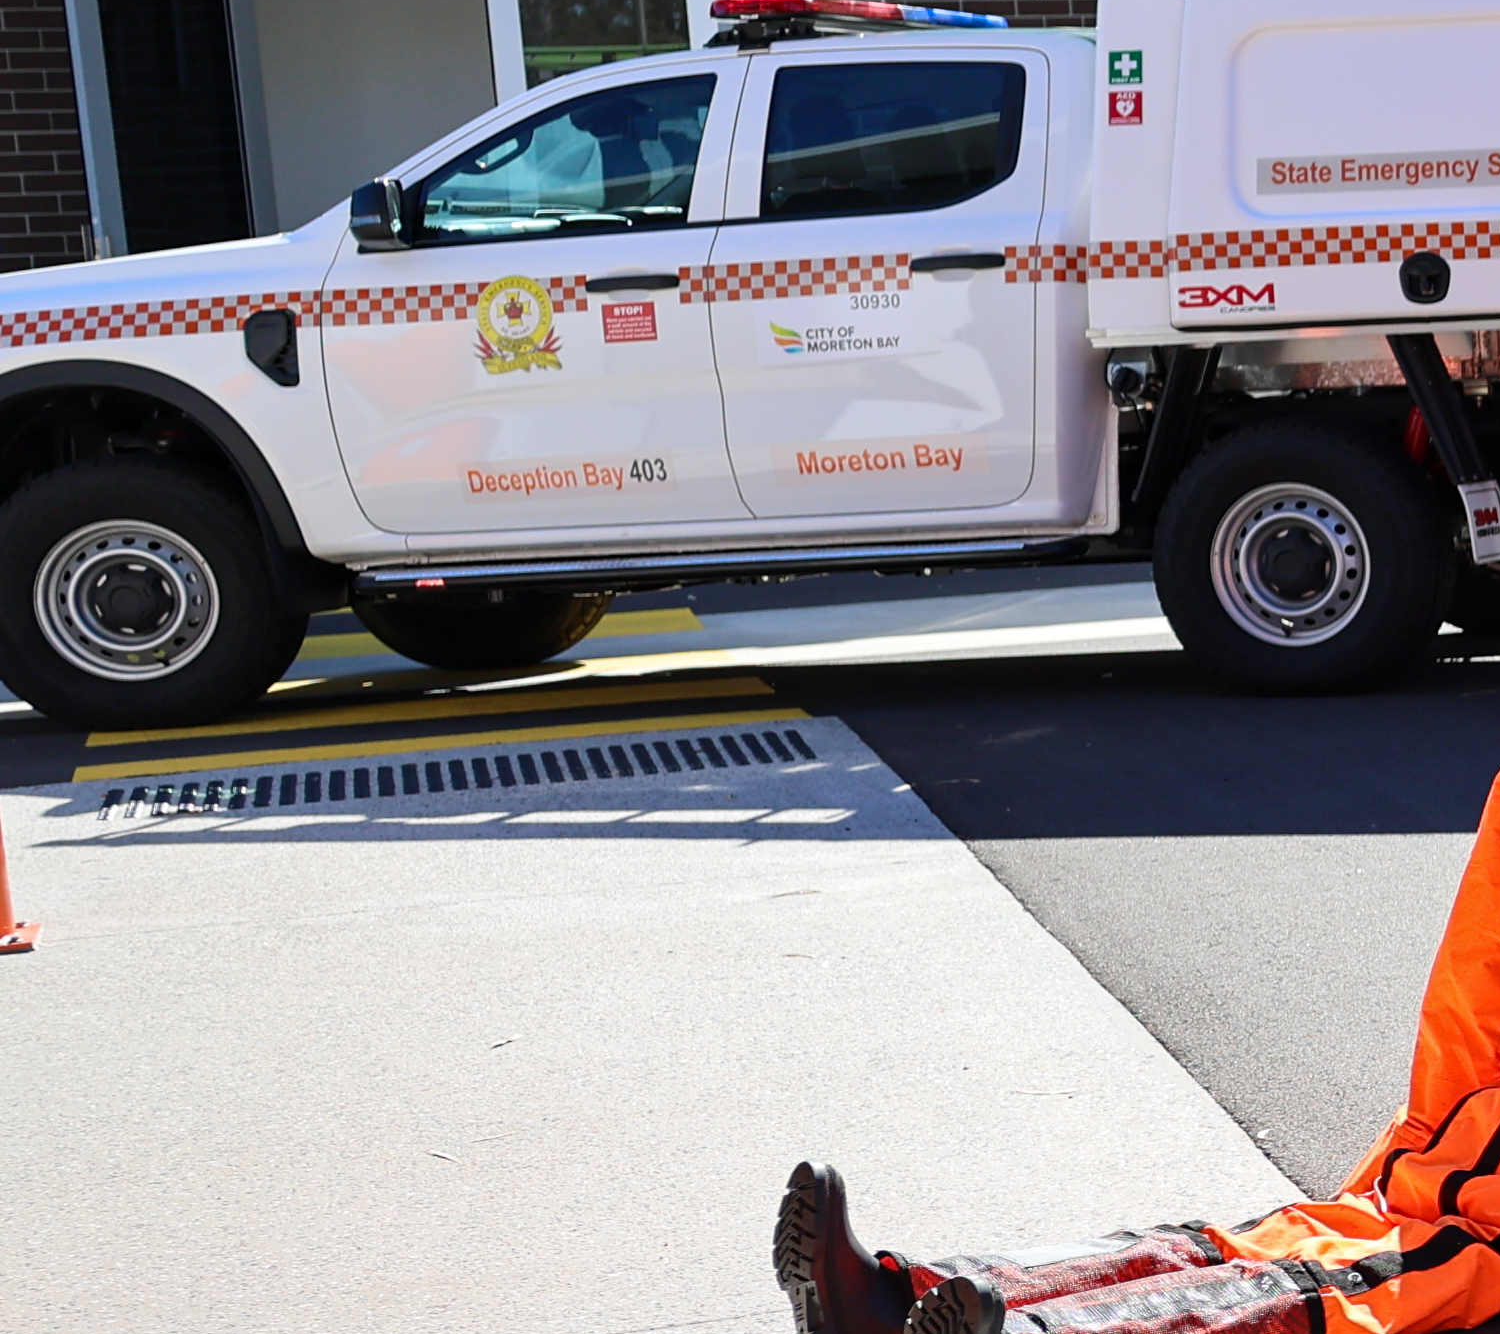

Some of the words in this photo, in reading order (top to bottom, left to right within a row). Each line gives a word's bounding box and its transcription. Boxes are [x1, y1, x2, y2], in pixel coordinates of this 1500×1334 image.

[1270, 161, 1332, 185] State
[1339, 155, 1480, 185] Emergency
[850, 293, 900, 310] 30930
[1177, 282, 1276, 308] 3XM
[613, 305, 643, 316] STOP!
[805, 327, 835, 340] CITY
[838, 326, 855, 338] OF
[807, 337, 873, 353] MORETON
[877, 336, 900, 349] BAY
[796, 450, 907, 475] Moreton
[914, 444, 964, 470] Bay
[467, 463, 579, 496] Deception
[583, 462, 624, 490] Bay
[629, 458, 668, 484] 403
